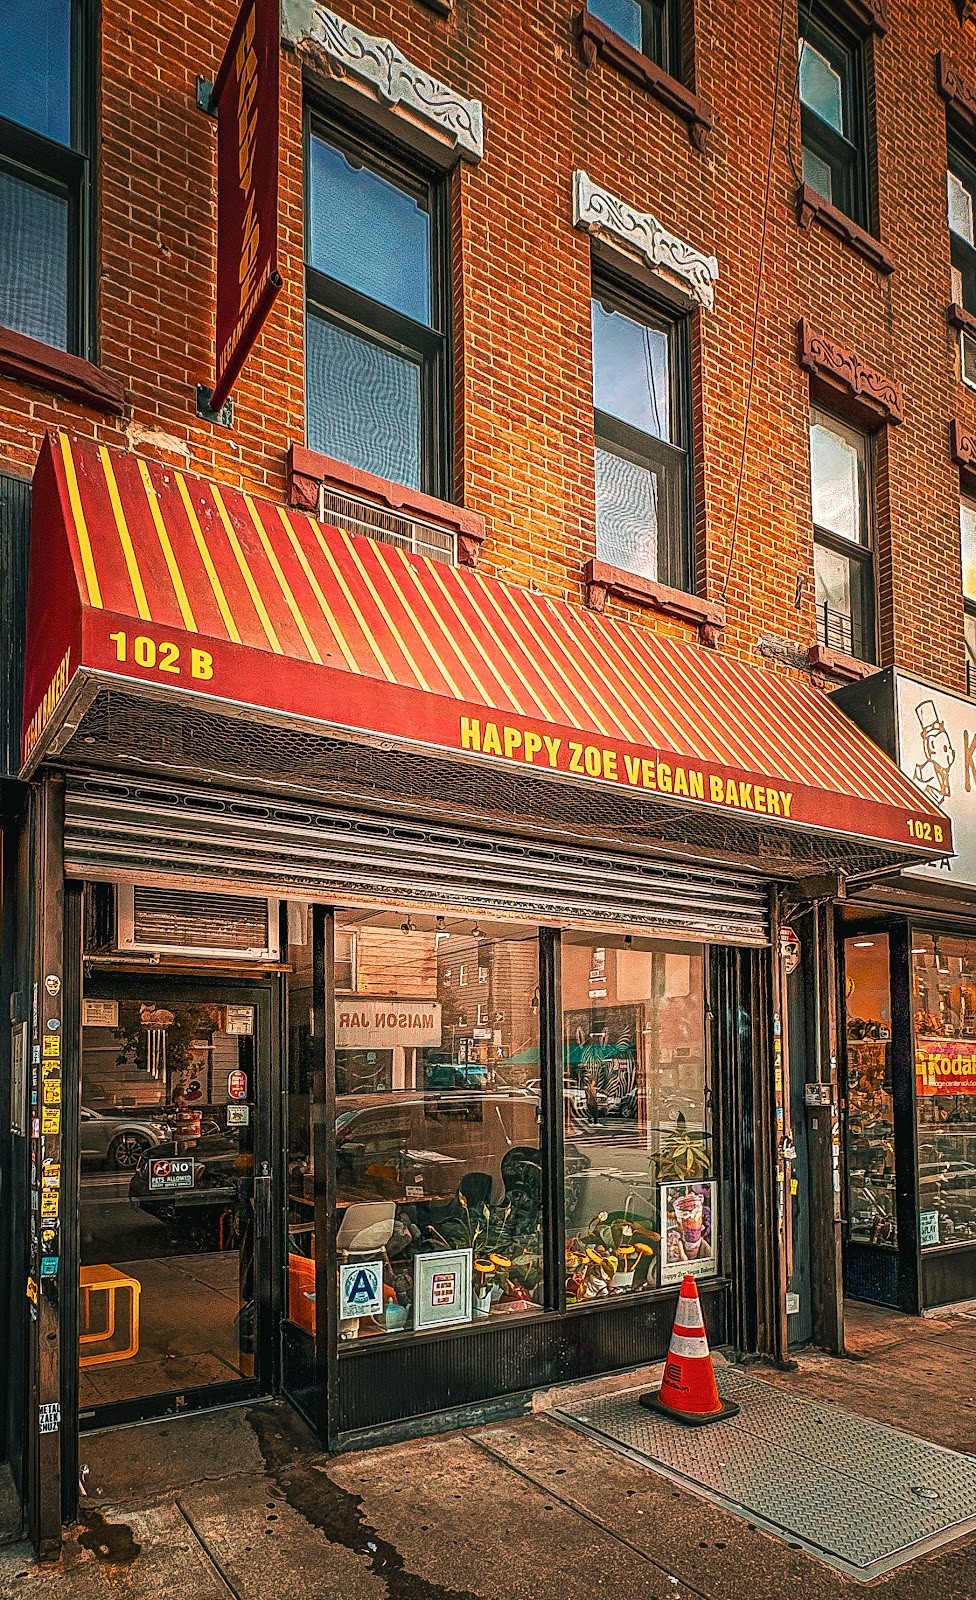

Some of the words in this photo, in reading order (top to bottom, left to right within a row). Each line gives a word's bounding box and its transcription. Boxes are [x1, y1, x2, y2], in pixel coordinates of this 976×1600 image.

[236, 2, 259, 200] HAPPY
[239, 187, 260, 315] ZOE
[219, 317, 244, 377] VEGAN
[109, 631, 181, 674] 102
[191, 648, 214, 681] B
[460, 716, 562, 768] HAPPY
[568, 742, 619, 781] ZOE
[623, 754, 705, 800] VEGAN
[709, 774, 793, 818] BAKERY
[907, 819, 932, 842] 102
[934, 824, 944, 843] B
[172, 1163, 189, 1173] NO
[347, 1269, 376, 1304] A
